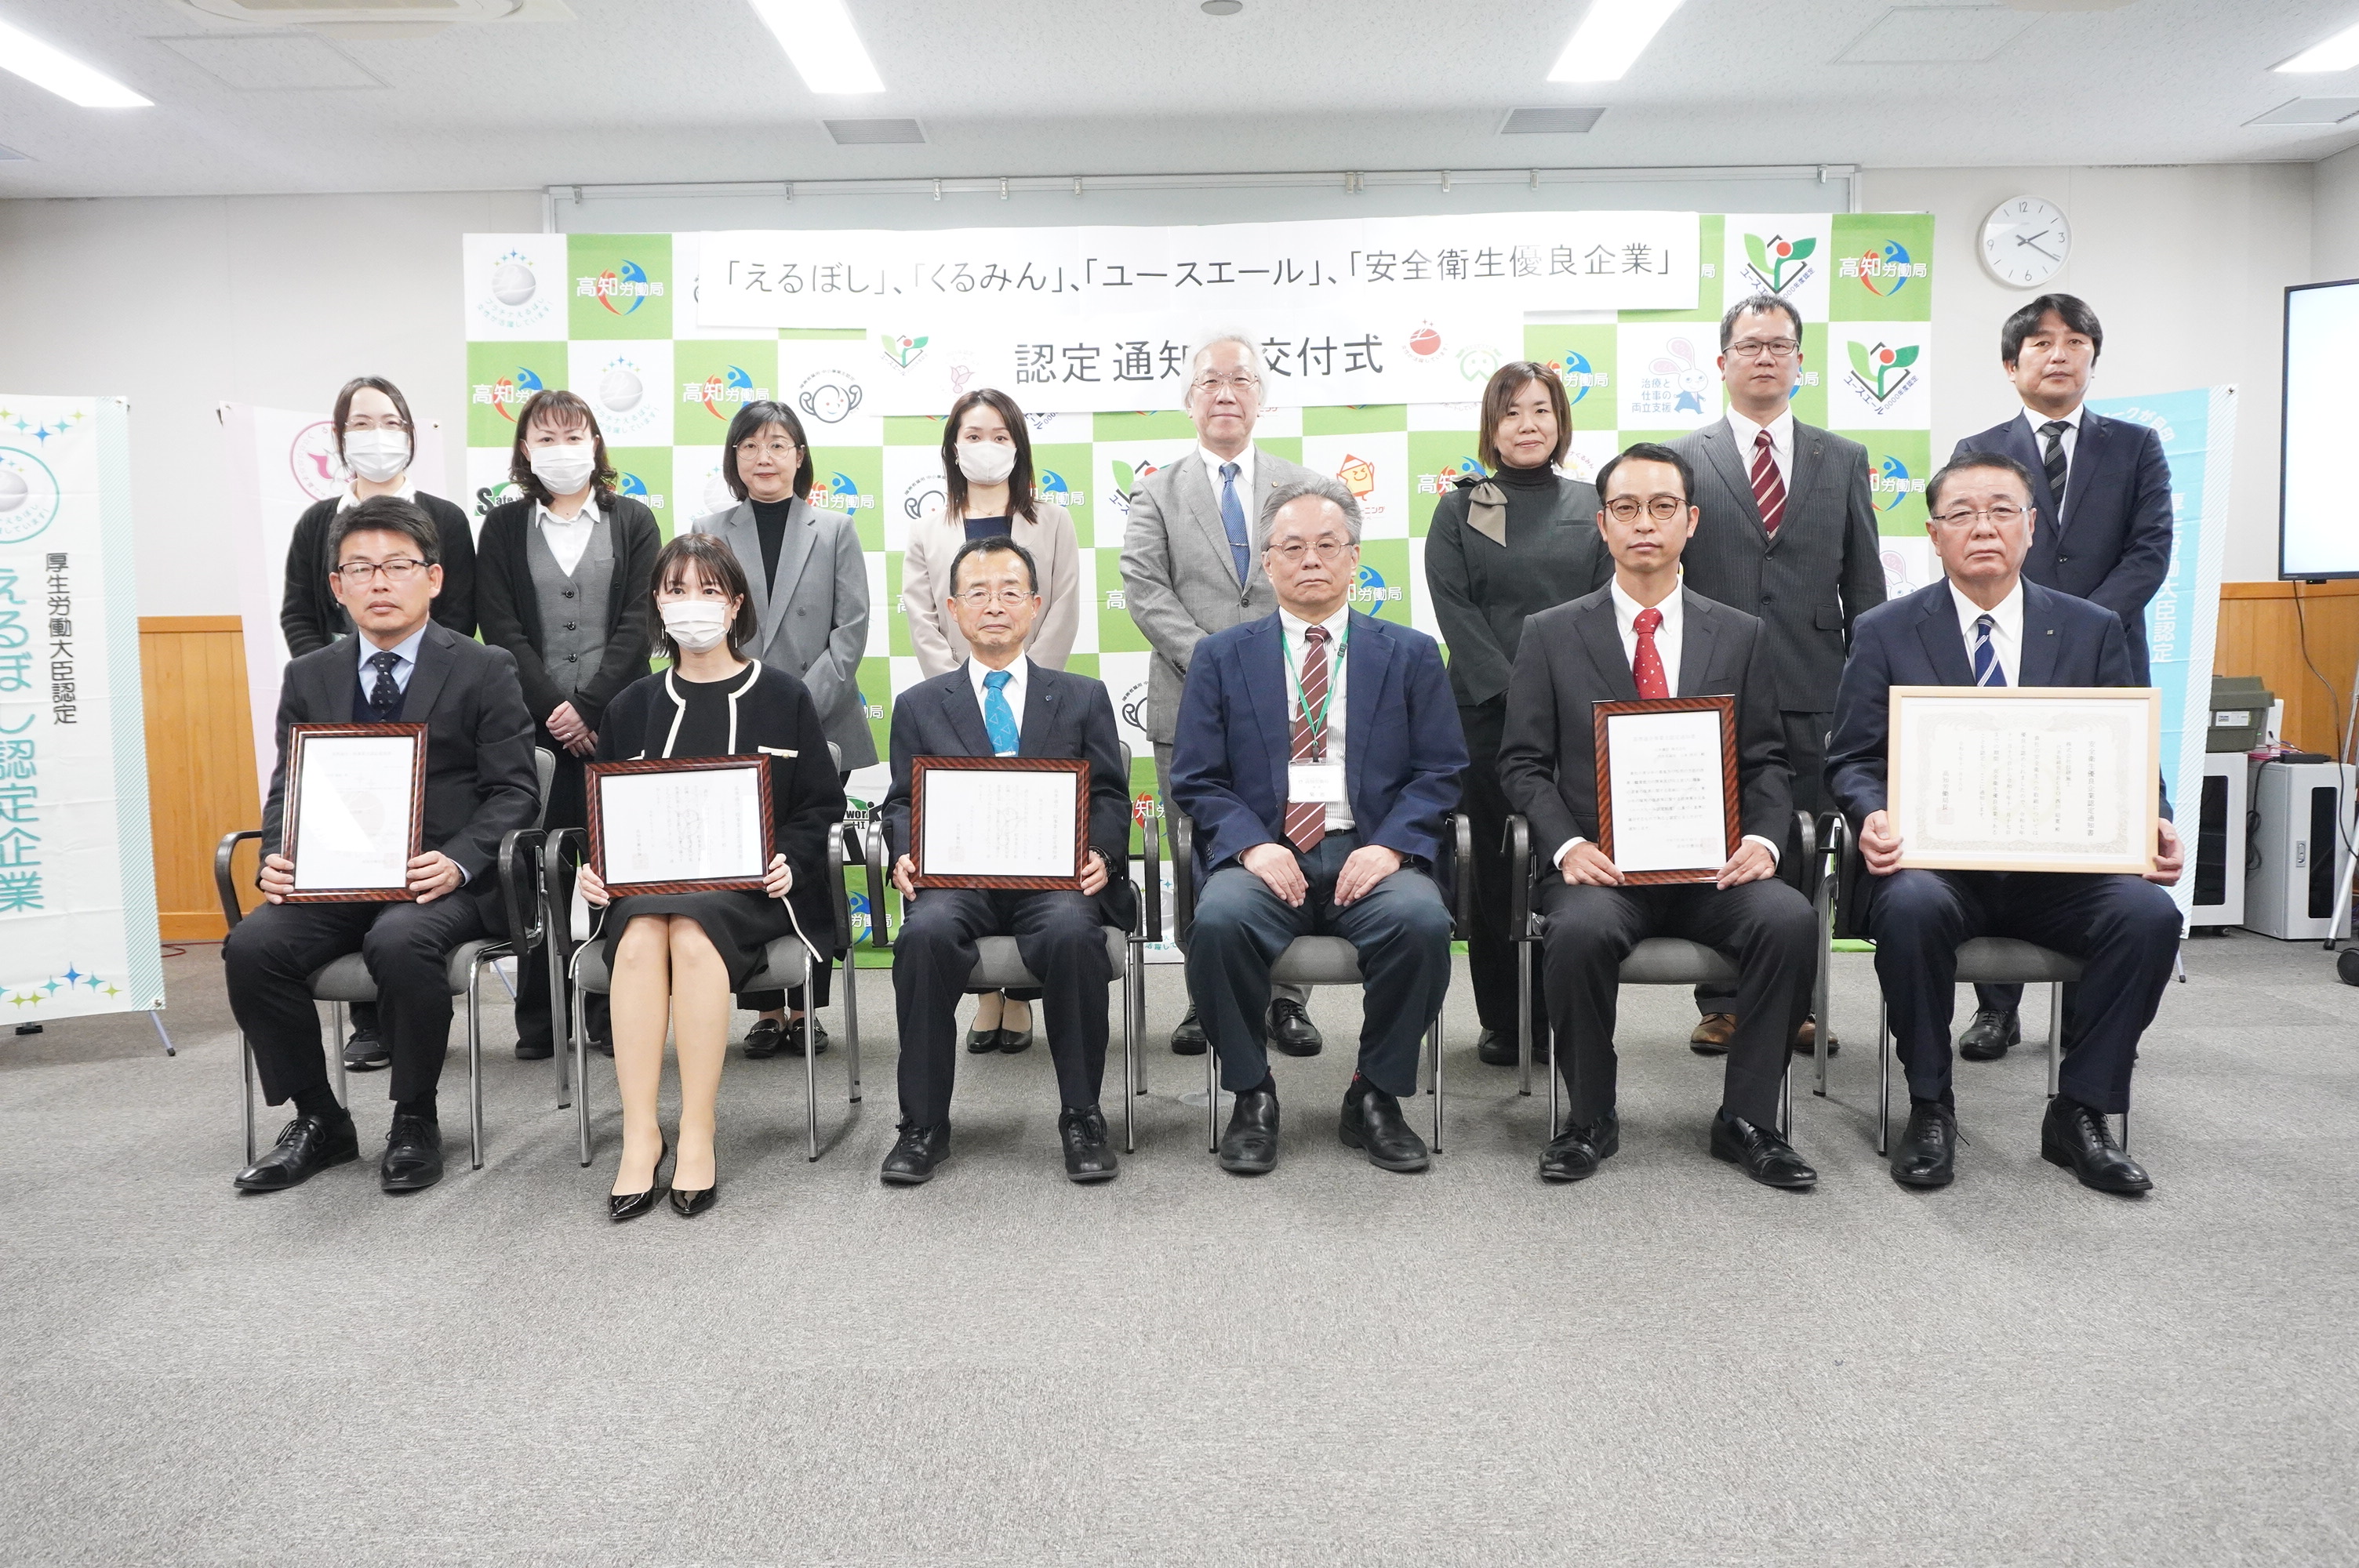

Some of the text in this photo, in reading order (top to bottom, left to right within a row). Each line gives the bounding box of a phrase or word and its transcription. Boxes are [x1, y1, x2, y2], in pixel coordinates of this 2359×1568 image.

[2019, 201, 2028, 212] 12
[1986, 239, 1994, 251] 9
[2058, 232, 2066, 243] 3
[728, 241, 1669, 295] 「えるぼし」、「くるみん」、「ユースエール」、「安全衛生優良企業」
[1838, 256, 1928, 278] 高知労働局
[2024, 270, 2033, 281] 6
[576, 276, 664, 297] 高知労働局
[1739, 268, 1769, 296] ユースエ
[1014, 332, 1384, 384] 認定通知交付式
[1561, 369, 1609, 388] 労働局
[471, 383, 536, 405] 高知労
[682, 381, 770, 402] 高知労働局
[1843, 376, 1885, 415] ユースエール
[1631, 402, 1672, 413] 両立支援
[1870, 472, 1927, 494] 労働局
[809, 488, 877, 510] 知労働局
[1030, 489, 1085, 507] 労働局
[1109, 494, 1129, 516] ユース
[1347, 583, 1403, 603] 労働局
[45, 552, 78, 725] 厚生労働大臣認定
